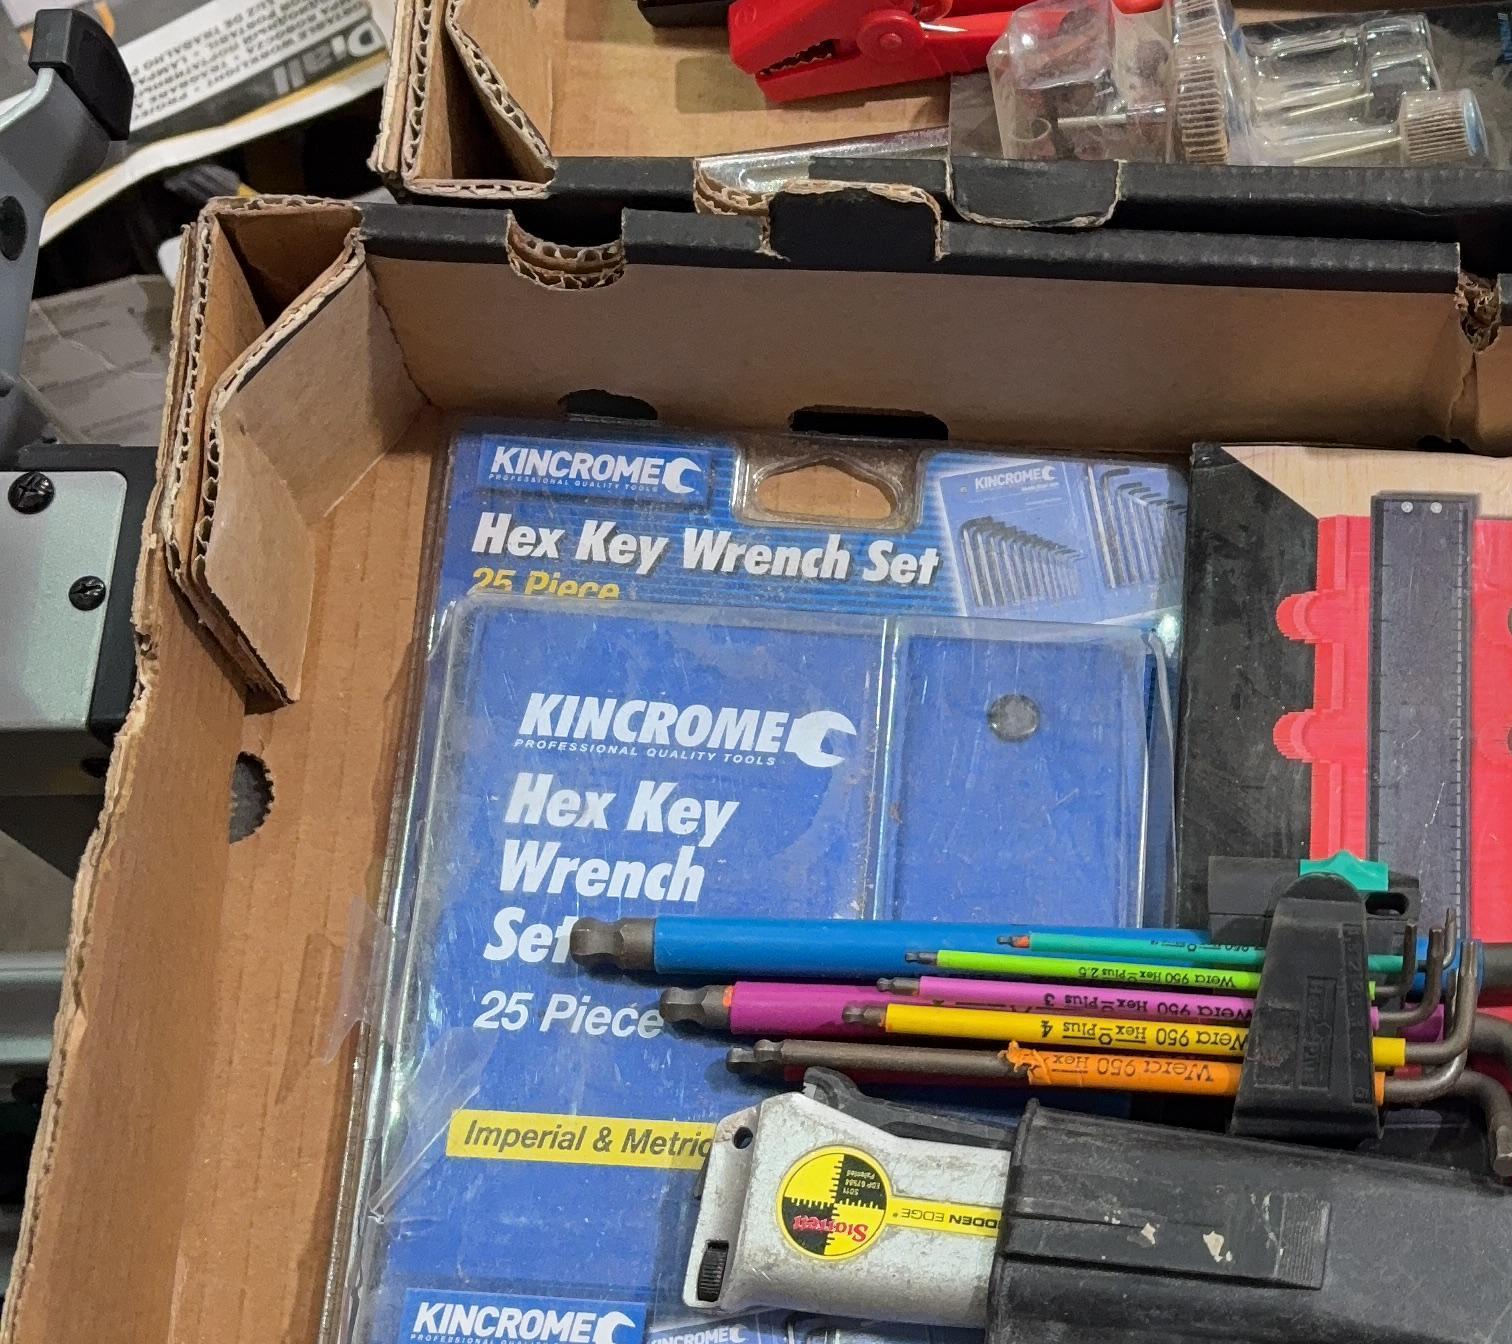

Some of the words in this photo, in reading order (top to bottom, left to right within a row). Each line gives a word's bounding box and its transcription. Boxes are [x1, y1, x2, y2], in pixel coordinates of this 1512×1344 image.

[490, 446, 664, 484] KINCROME
[488, 473, 568, 485] PROFESSIONAL
[574, 480, 619, 489] QUALITY
[471, 511, 565, 559] Hex
[574, 518, 669, 575] Key
[682, 528, 852, 579] Wrench
[861, 539, 940, 587] Set
[471, 566, 517, 592] 25
[524, 570, 620, 599] Piece
[517, 692, 790, 752] KINCROME
[512, 737, 637, 756] PROFESSIONAL
[646, 748, 715, 761] QUALITY
[723, 753, 776, 765] TOOLS
[504, 772, 616, 830] Hex
[625, 780, 739, 847] Key
[499, 839, 705, 902] Wrench
[482, 906, 579, 963] Set
[1164, 972, 1189, 983] 950
[1194, 973, 1233, 987] Wera
[472, 990, 533, 1031] 25
[539, 993, 666, 1038] Piece
[1039, 1020, 1053, 1038] 4
[1155, 1027, 1189, 1046] 950
[1194, 1030, 1246, 1050] Wera
[1096, 1056, 1136, 1077] 950
[1144, 1058, 1214, 1082] Wera
[464, 1119, 590, 1154] Imperial
[593, 1127, 616, 1153] &
[621, 1127, 713, 1158] Metric
[791, 1214, 868, 1243] Starrett
[900, 1207, 944, 1222] EDGE
[949, 1214, 1000, 1229] DDEN
